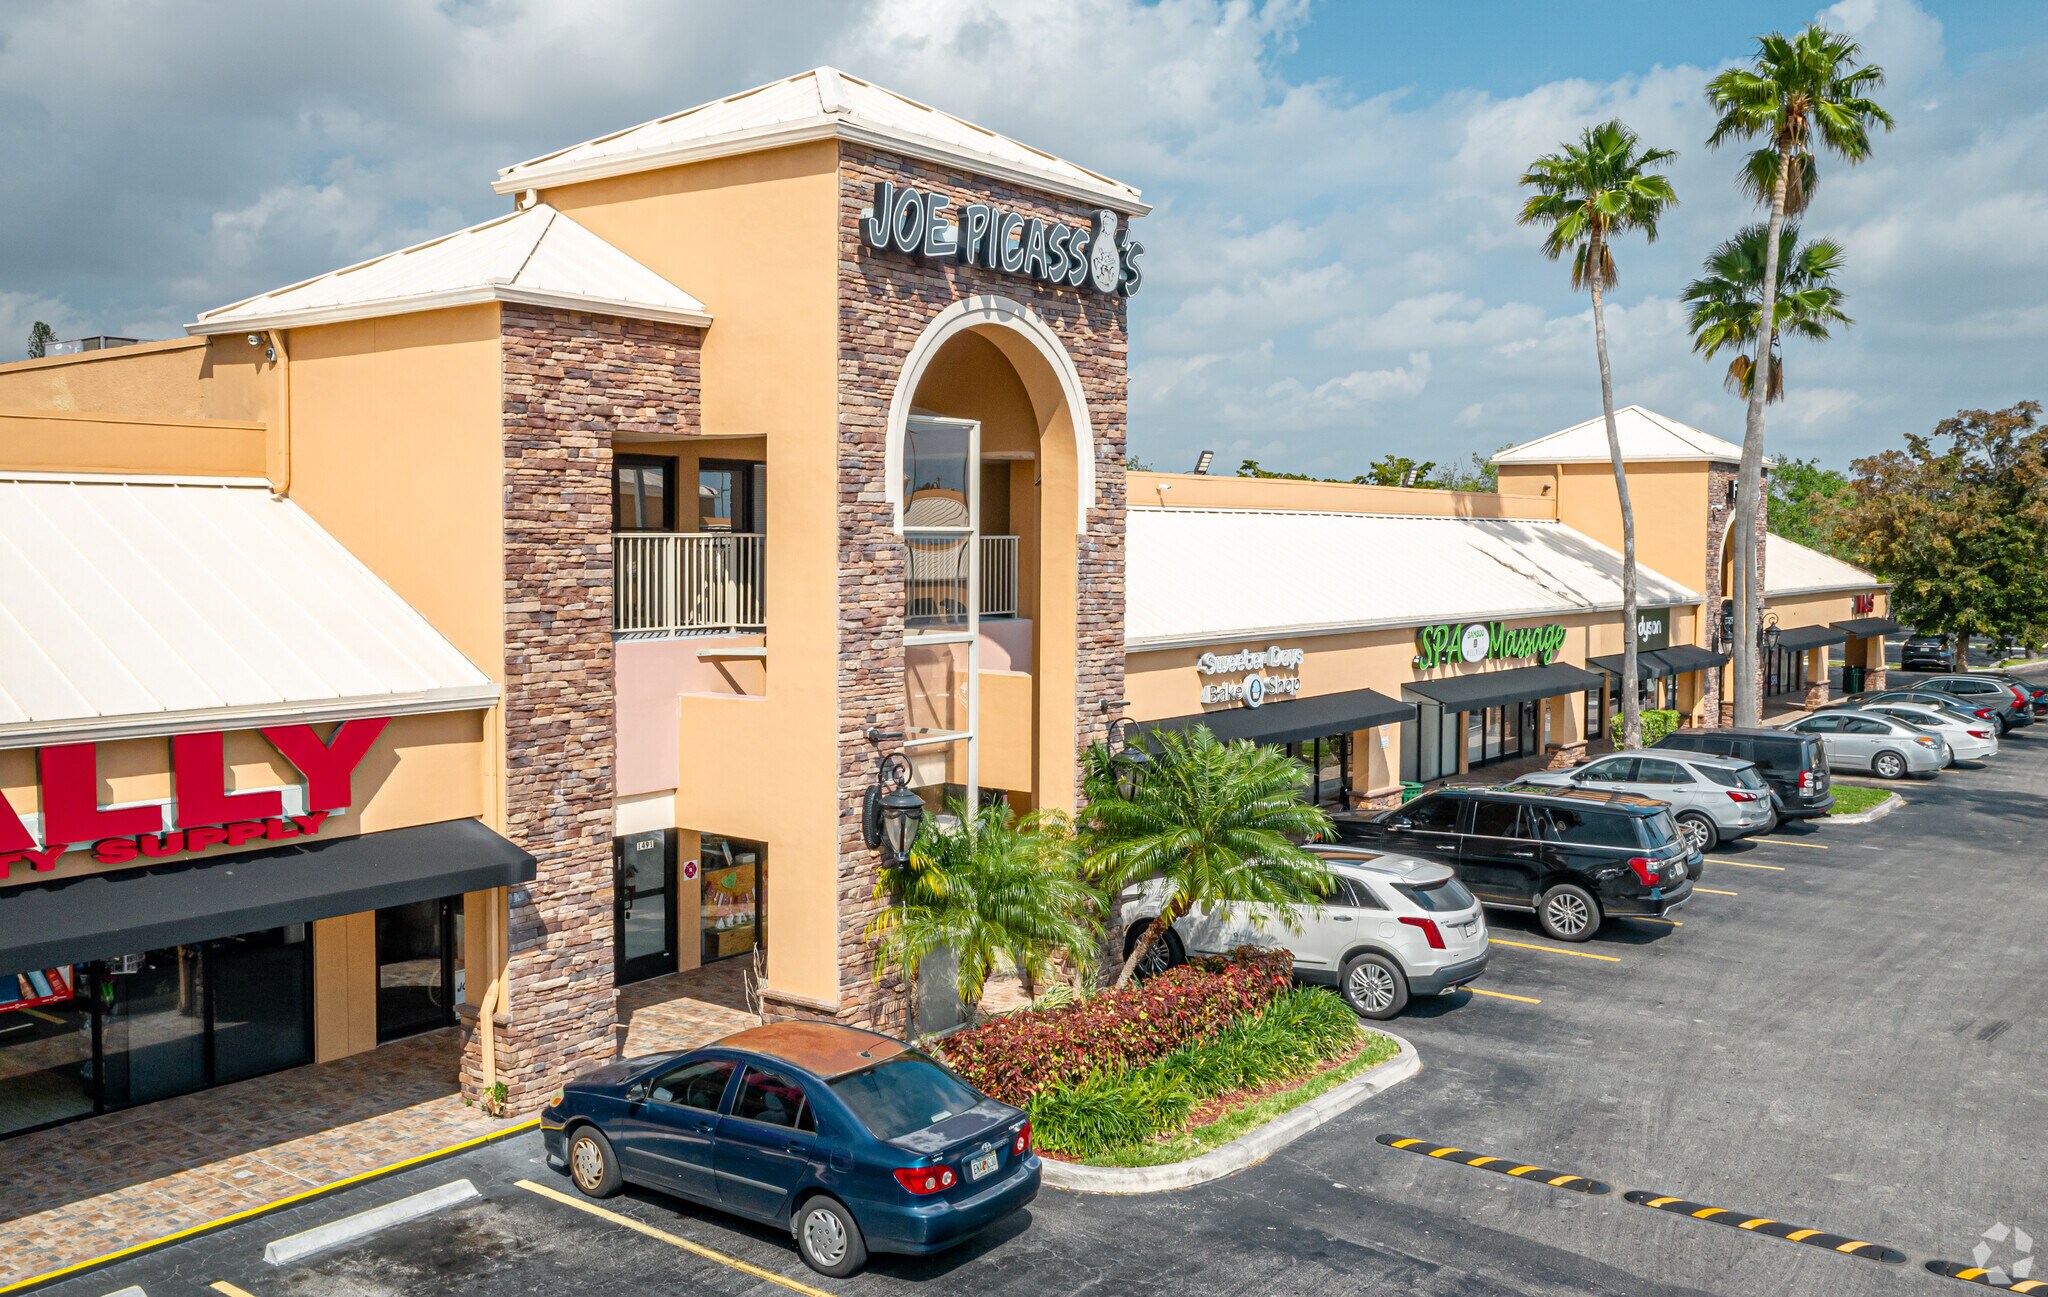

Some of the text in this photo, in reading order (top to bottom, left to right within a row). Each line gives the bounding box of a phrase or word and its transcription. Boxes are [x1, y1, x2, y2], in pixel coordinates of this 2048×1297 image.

[862, 181, 957, 256] JOE
[1637, 615, 1662, 643] dyson
[1198, 646, 1304, 675] Sweeter Days
[1417, 621, 1568, 671] SPA Massage
[1206, 675, 1301, 703] Bake Shop
[95, 811, 330, 864] SUPPLY
[637, 840, 654, 850] 1491
